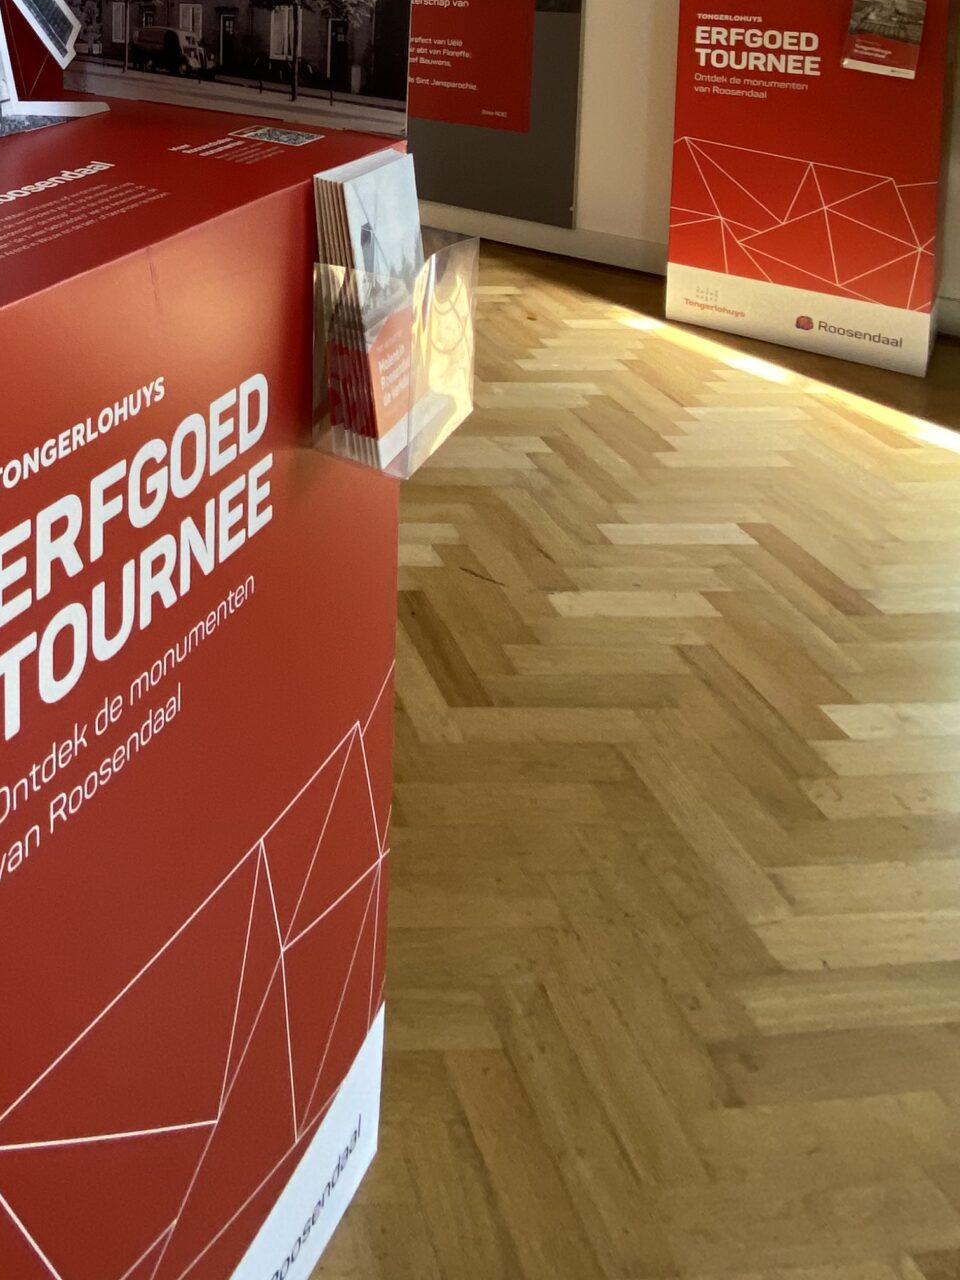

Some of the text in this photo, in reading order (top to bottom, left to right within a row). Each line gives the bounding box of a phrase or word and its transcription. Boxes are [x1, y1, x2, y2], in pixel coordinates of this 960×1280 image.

[697, 12, 763, 23] TONGERLOHUYS
[695, 25, 819, 52] ERFGOED
[694, 48, 821, 76] TOURNEE
[694, 72, 809, 91] Ontdek de monumenten
[694, 85, 768, 99] van Roosendaal
[818, 320, 904, 348] Roosendaal
[94, 694, 123, 736] de
[130, 575, 256, 708] monumenten
[49, 682, 182, 835] Roosendaal
[270, 1113, 361, 1280] oosendaal
